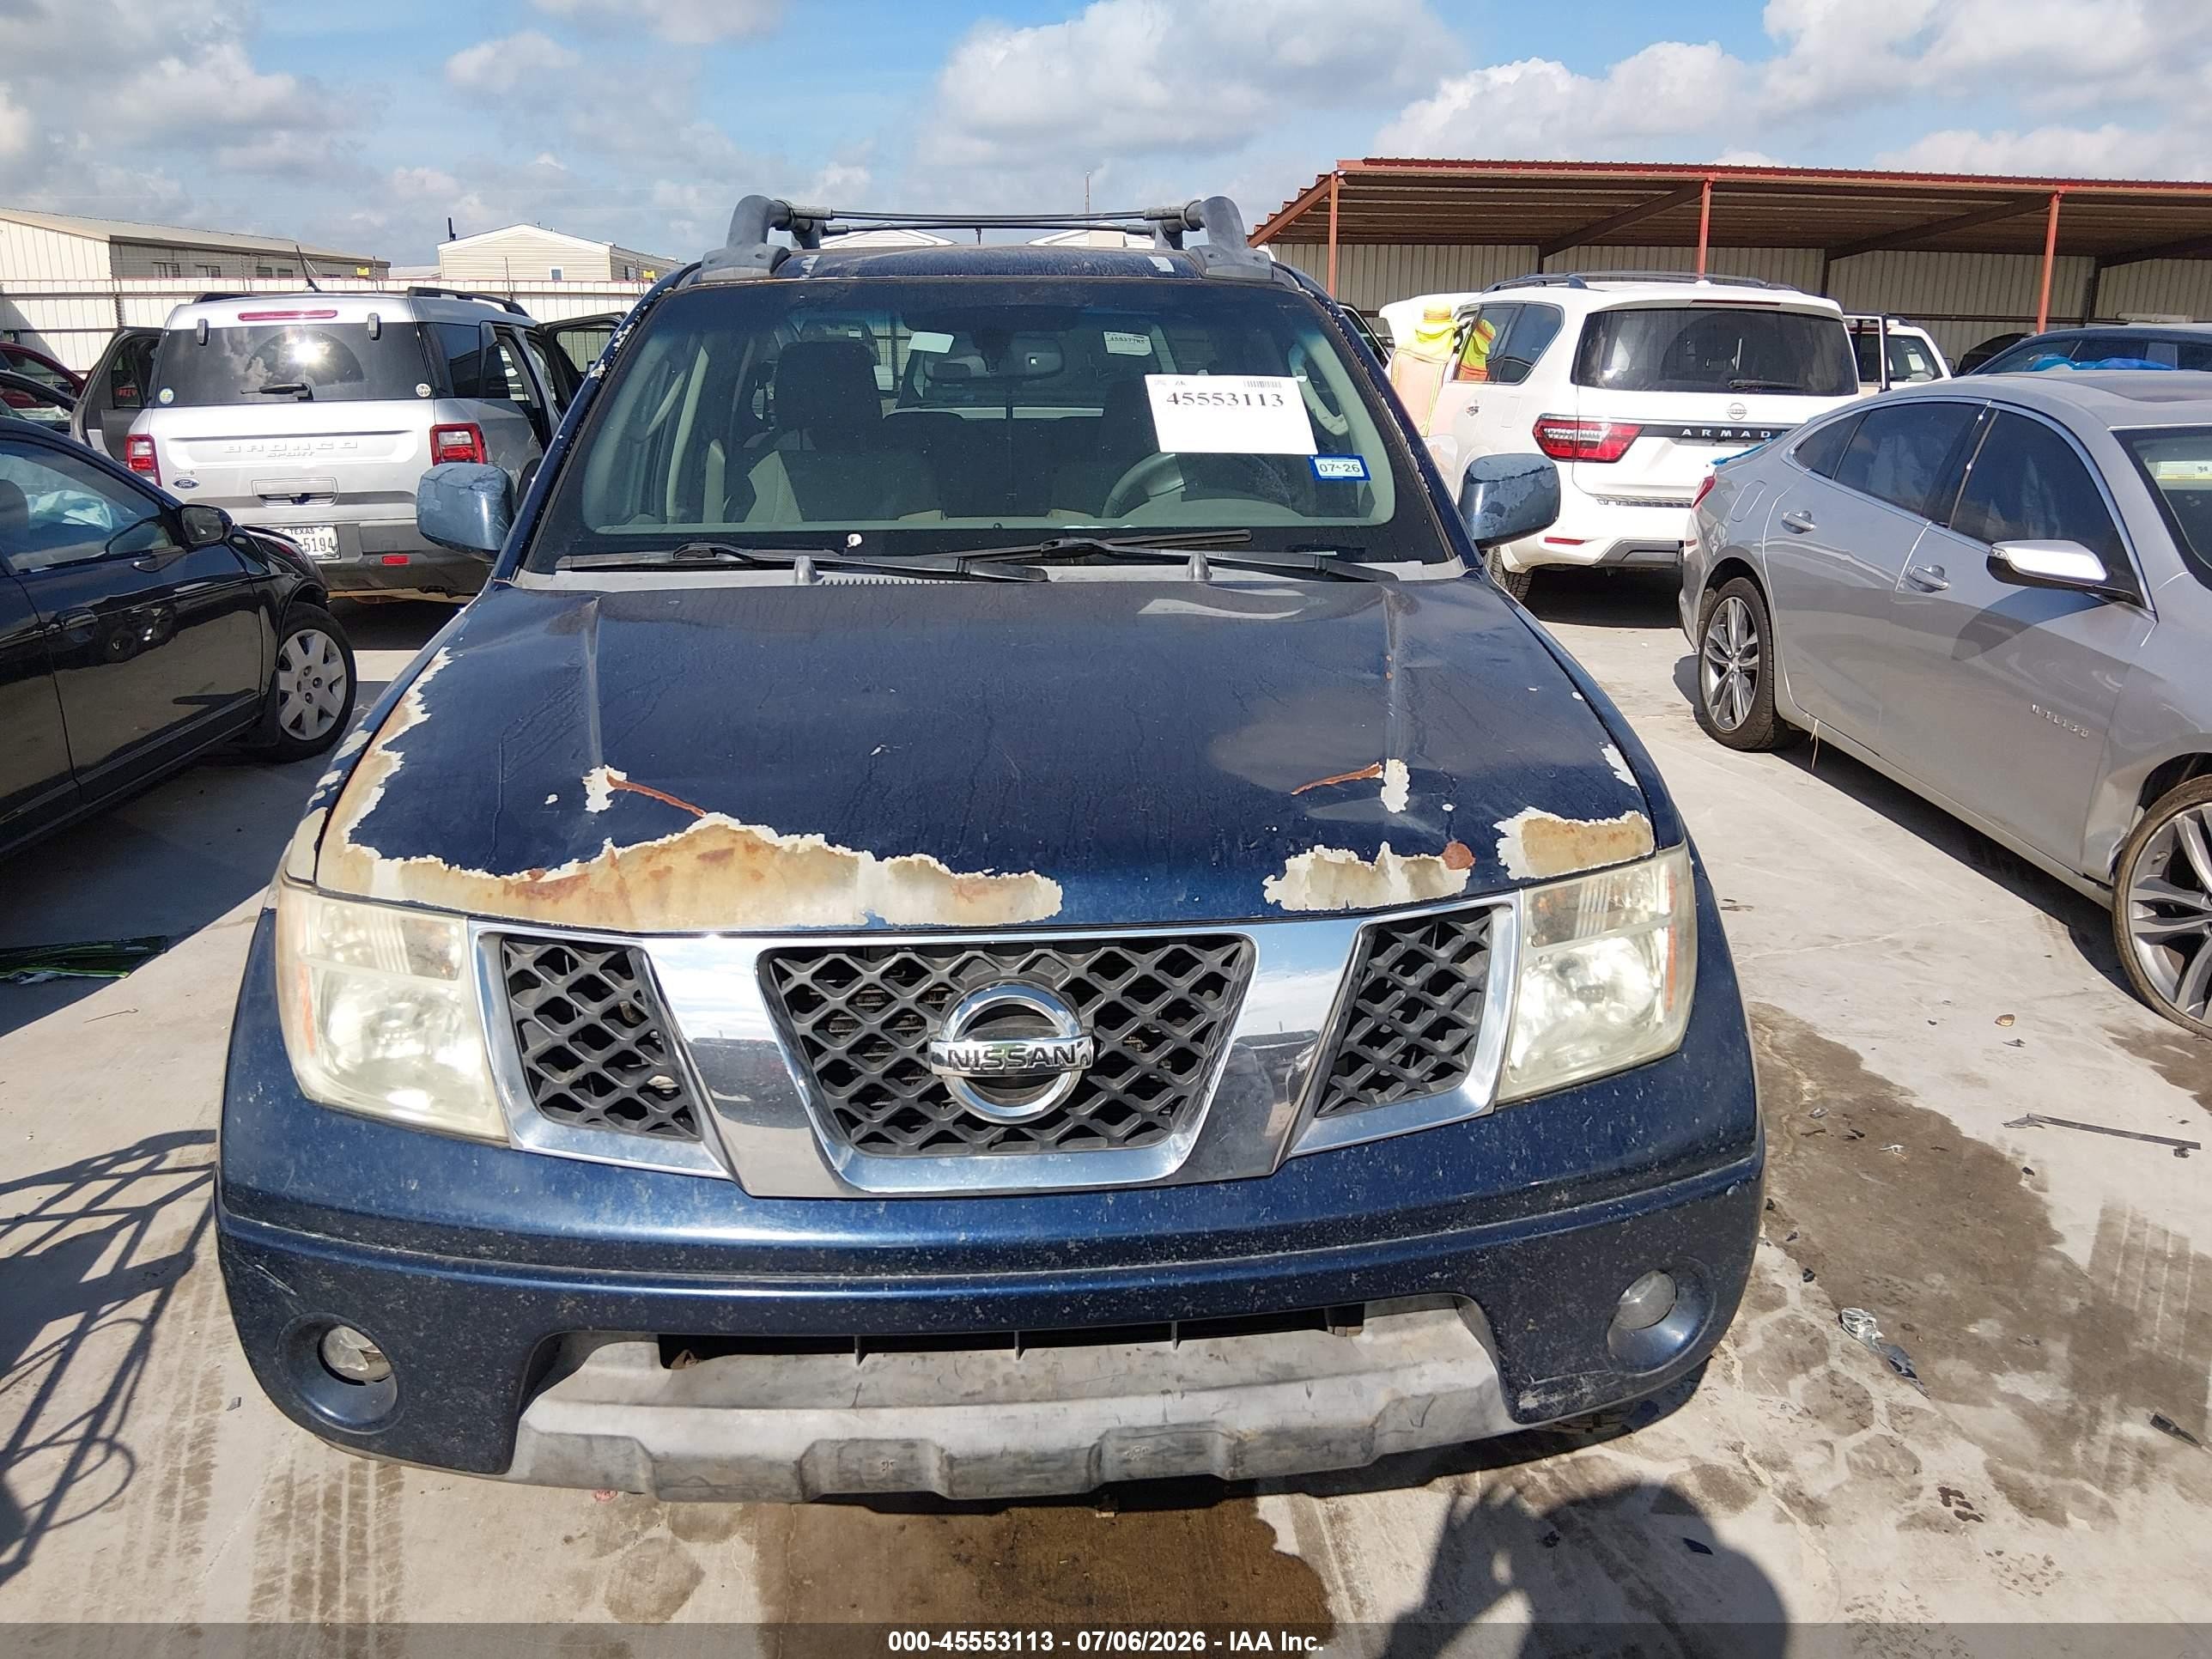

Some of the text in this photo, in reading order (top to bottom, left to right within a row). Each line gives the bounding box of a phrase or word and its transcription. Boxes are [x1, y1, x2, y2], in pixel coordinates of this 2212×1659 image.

[1166, 392, 1285, 407] 45553113
[1681, 428, 1771, 438] ARMAD
[946, 1043, 1077, 1071] NISSAN
